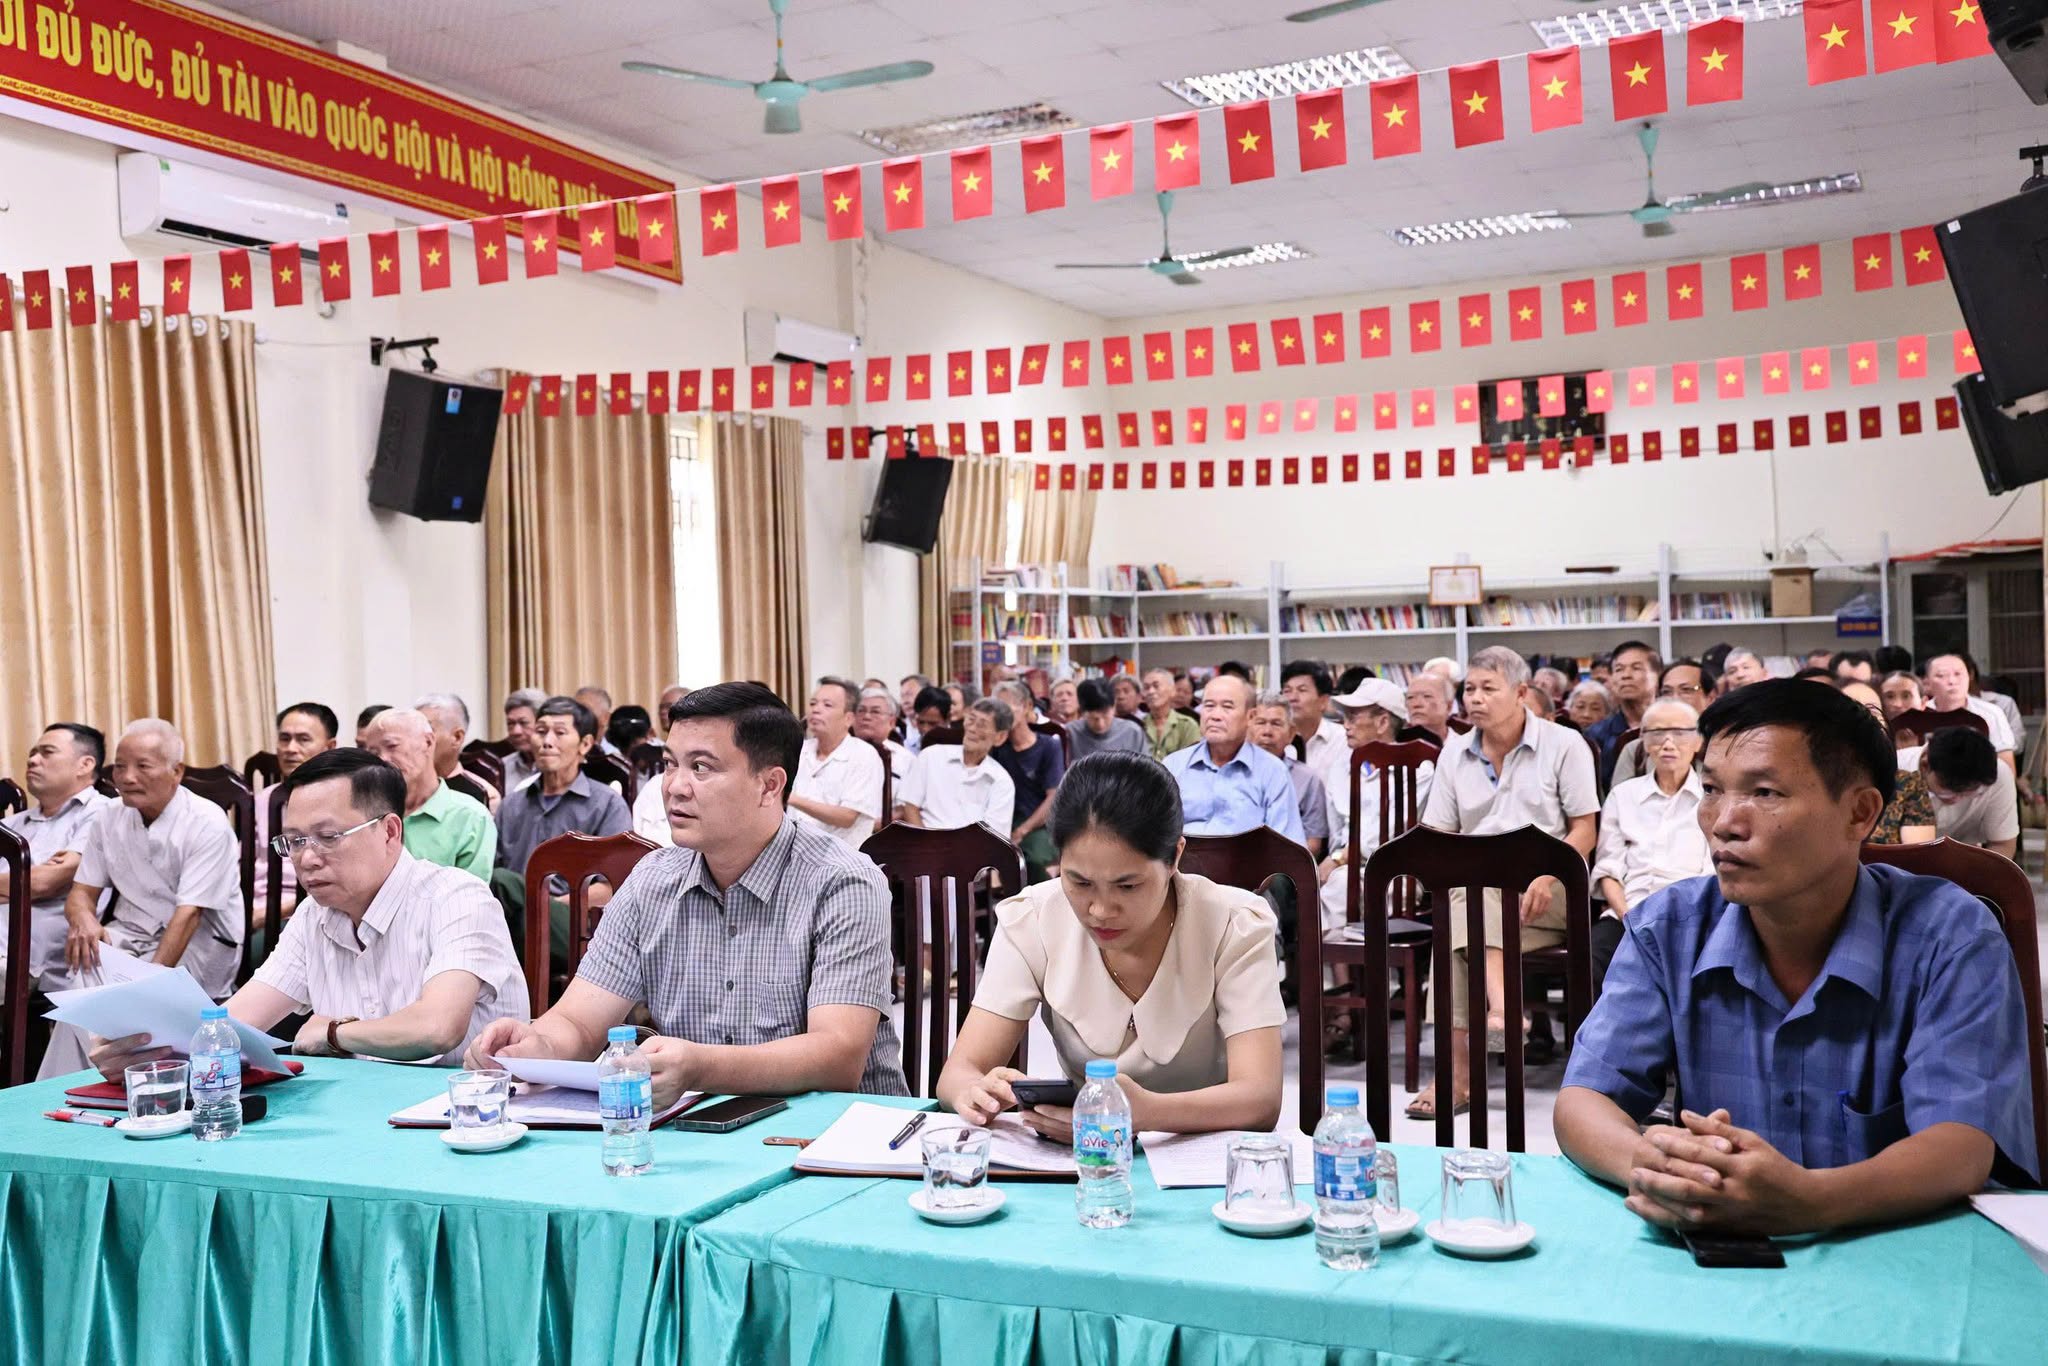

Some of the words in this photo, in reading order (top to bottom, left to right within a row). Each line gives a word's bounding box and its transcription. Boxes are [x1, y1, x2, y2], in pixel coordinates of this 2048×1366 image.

[36, 0, 82, 67] ĐỦ
[91, 22, 163, 98] ĐỨC,
[171, 41, 211, 106] ĐỦ
[217, 60, 262, 122] TÀI
[266, 77, 318, 139] VÀO
[324, 97, 388, 160] QUỐC
[394, 119, 431, 180] HỘI
[436, 133, 465, 185] VÀ
[469, 144, 504, 203] HỘI
